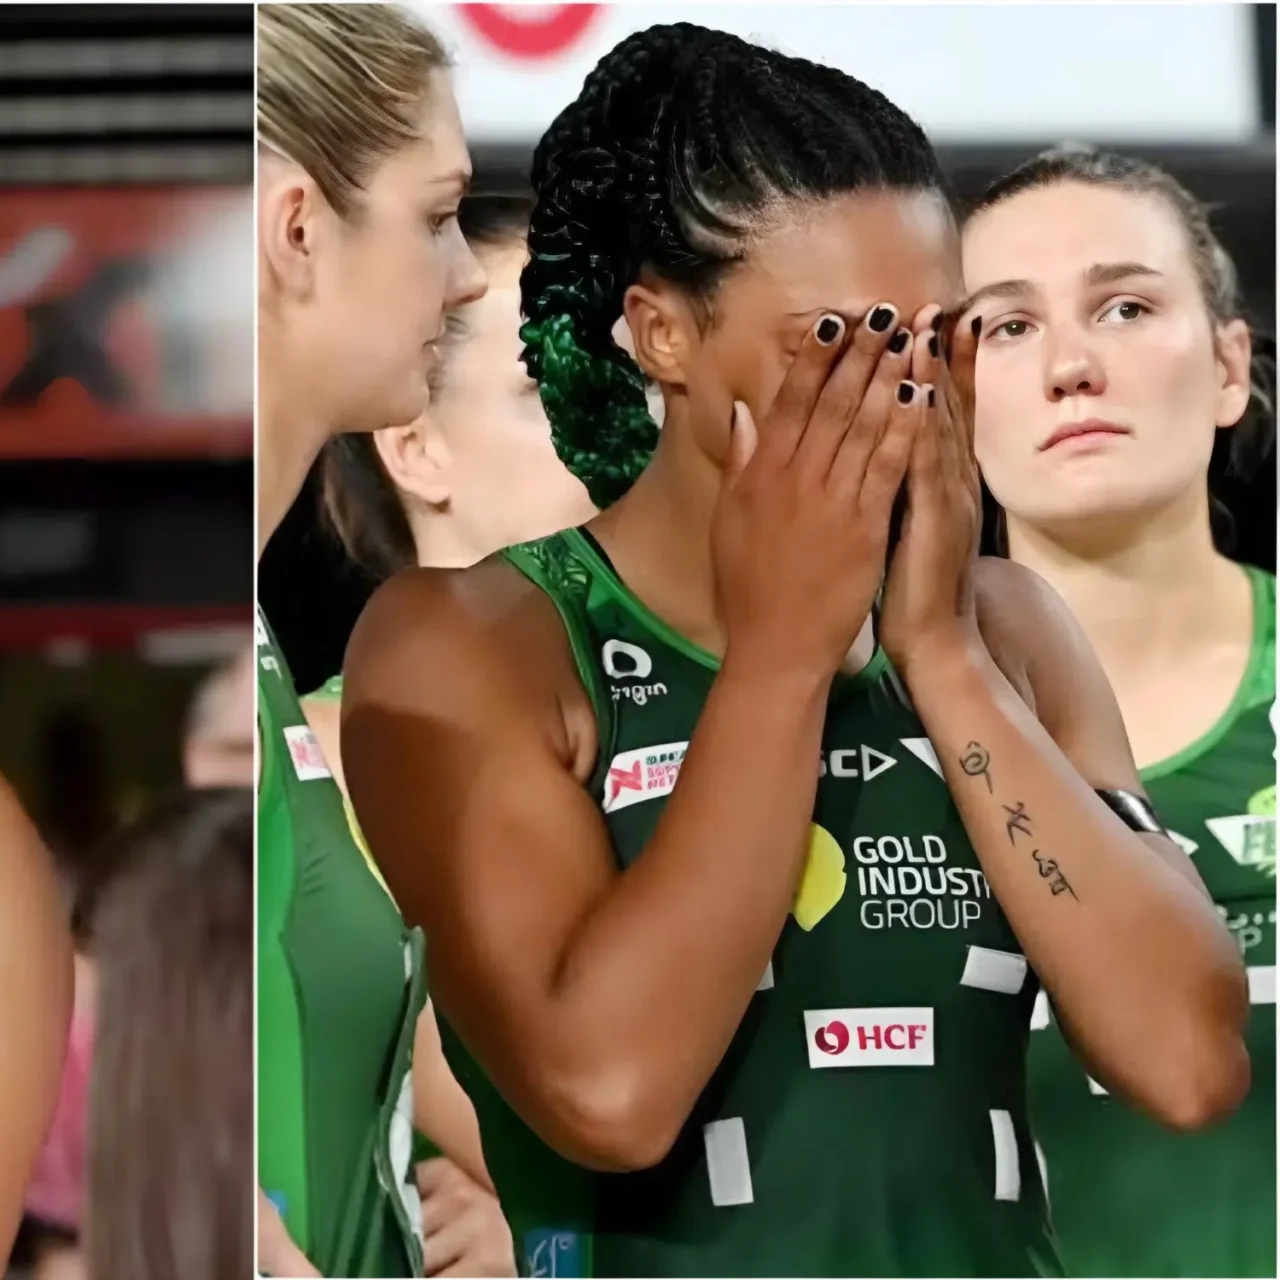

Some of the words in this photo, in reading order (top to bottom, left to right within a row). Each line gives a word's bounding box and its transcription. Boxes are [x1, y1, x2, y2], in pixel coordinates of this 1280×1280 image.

[853, 835, 947, 864] GOLD
[860, 898, 982, 930] GROUP
[856, 1024, 928, 1051] HCF
